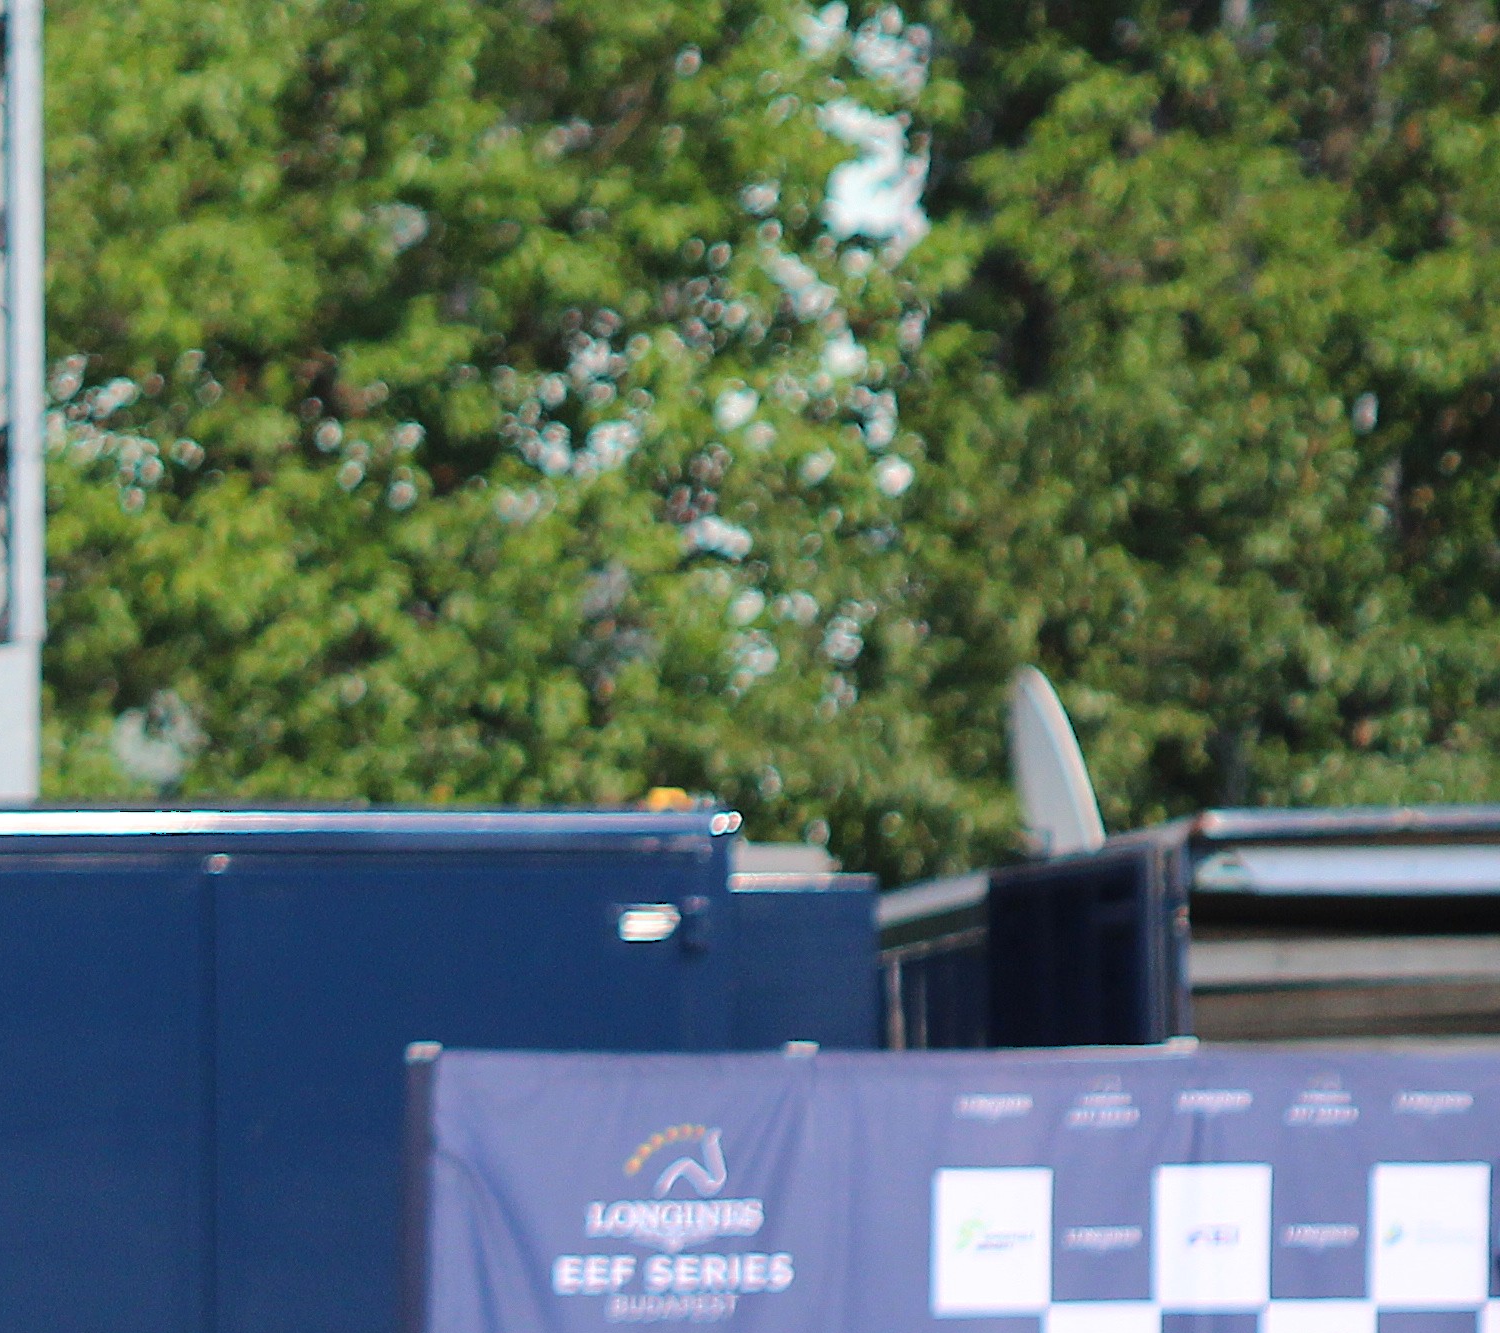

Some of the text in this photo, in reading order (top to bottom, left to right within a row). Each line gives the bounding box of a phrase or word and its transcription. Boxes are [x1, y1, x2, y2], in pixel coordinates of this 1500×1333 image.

[586, 1199, 764, 1238] LONGINES
[553, 1252, 795, 1295] EEF SERIES
